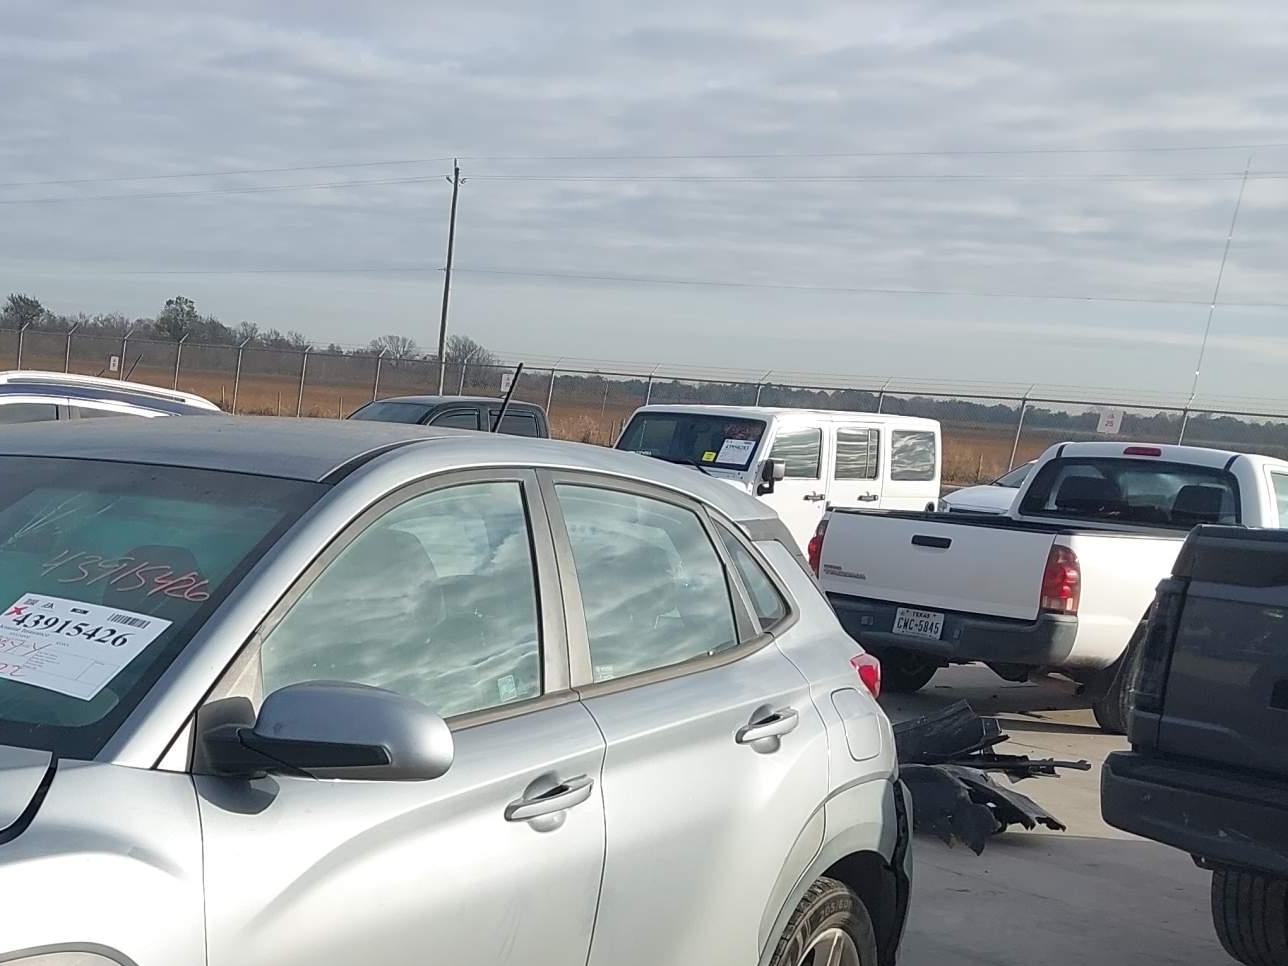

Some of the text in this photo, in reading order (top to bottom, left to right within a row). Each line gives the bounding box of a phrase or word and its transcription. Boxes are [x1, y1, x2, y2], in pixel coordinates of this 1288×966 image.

[40, 550, 210, 601] 43915426
[12, 612, 136, 648] 43915426
[912, 611, 930, 619] TEXAS
